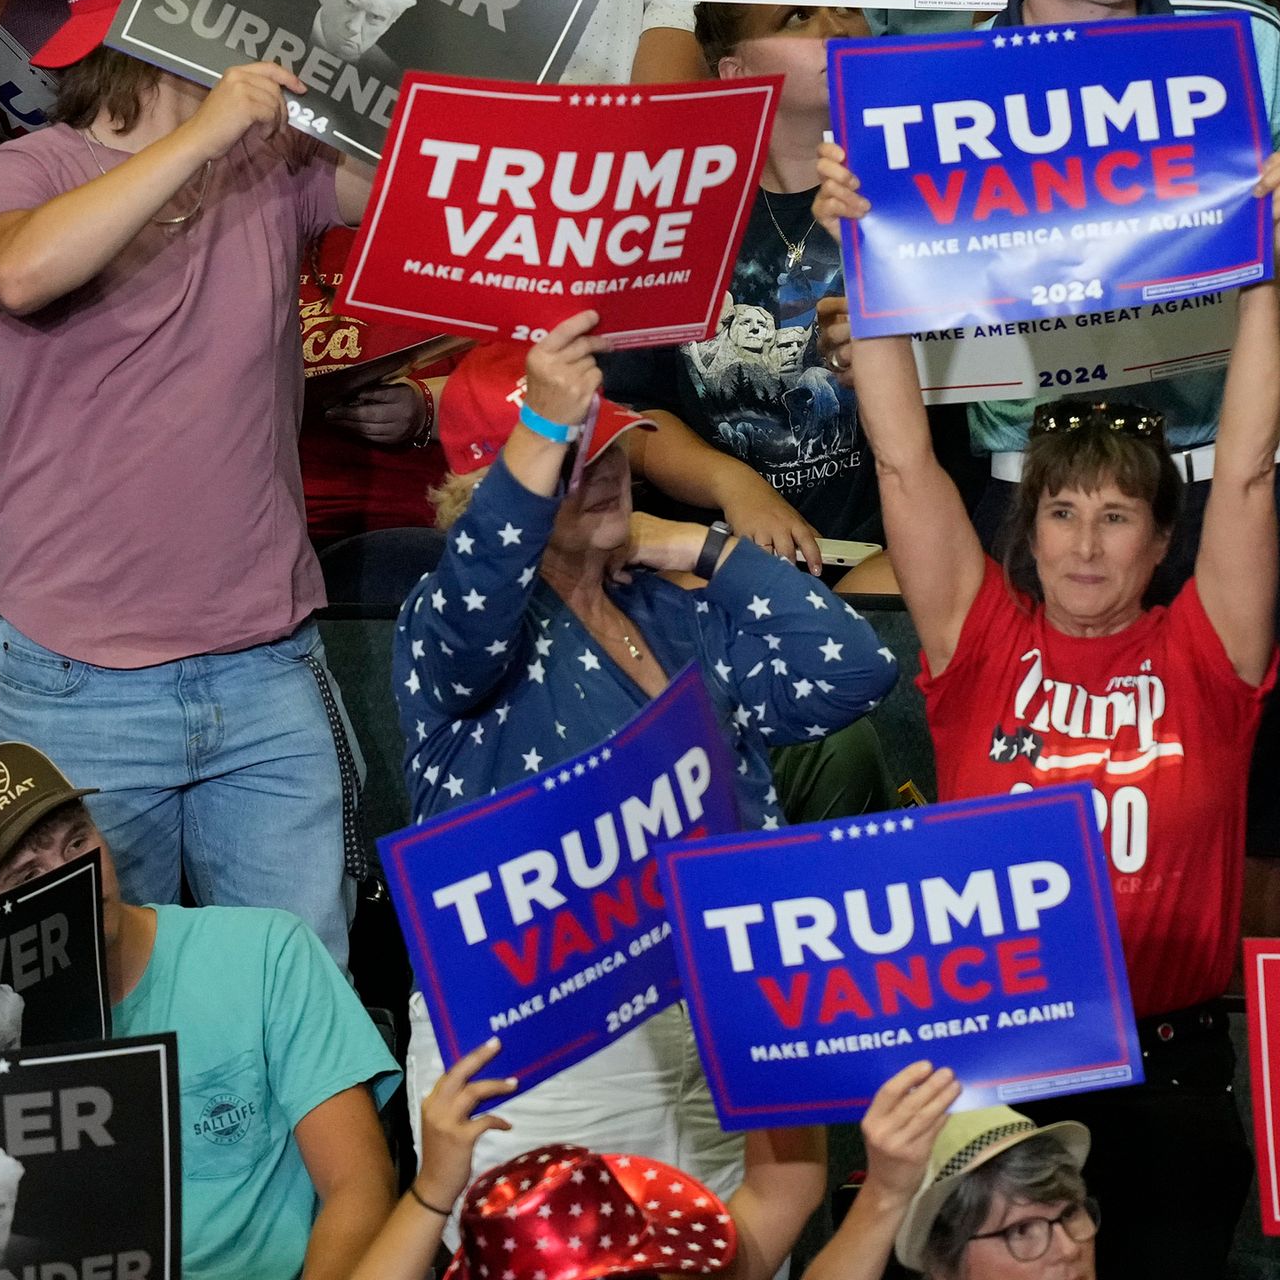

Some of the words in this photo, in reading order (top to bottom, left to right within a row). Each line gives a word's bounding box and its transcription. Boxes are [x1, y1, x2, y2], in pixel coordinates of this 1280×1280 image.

[863, 76, 1226, 169] TRUMP
[420, 139, 736, 212] TRUMP
[916, 146, 1196, 221] VANCE
[445, 207, 692, 267] VANCE
[1030, 280, 1103, 306] 2024
[1039, 364, 1107, 387] 2024
[431, 746, 712, 947] TRUMP
[704, 861, 1070, 972] TRUMP
[606, 985, 658, 1032] 2024
[756, 936, 1047, 1030] VANCE
[193, 1114, 227, 1137] SALT
[226, 1104, 257, 1129] LIFE
